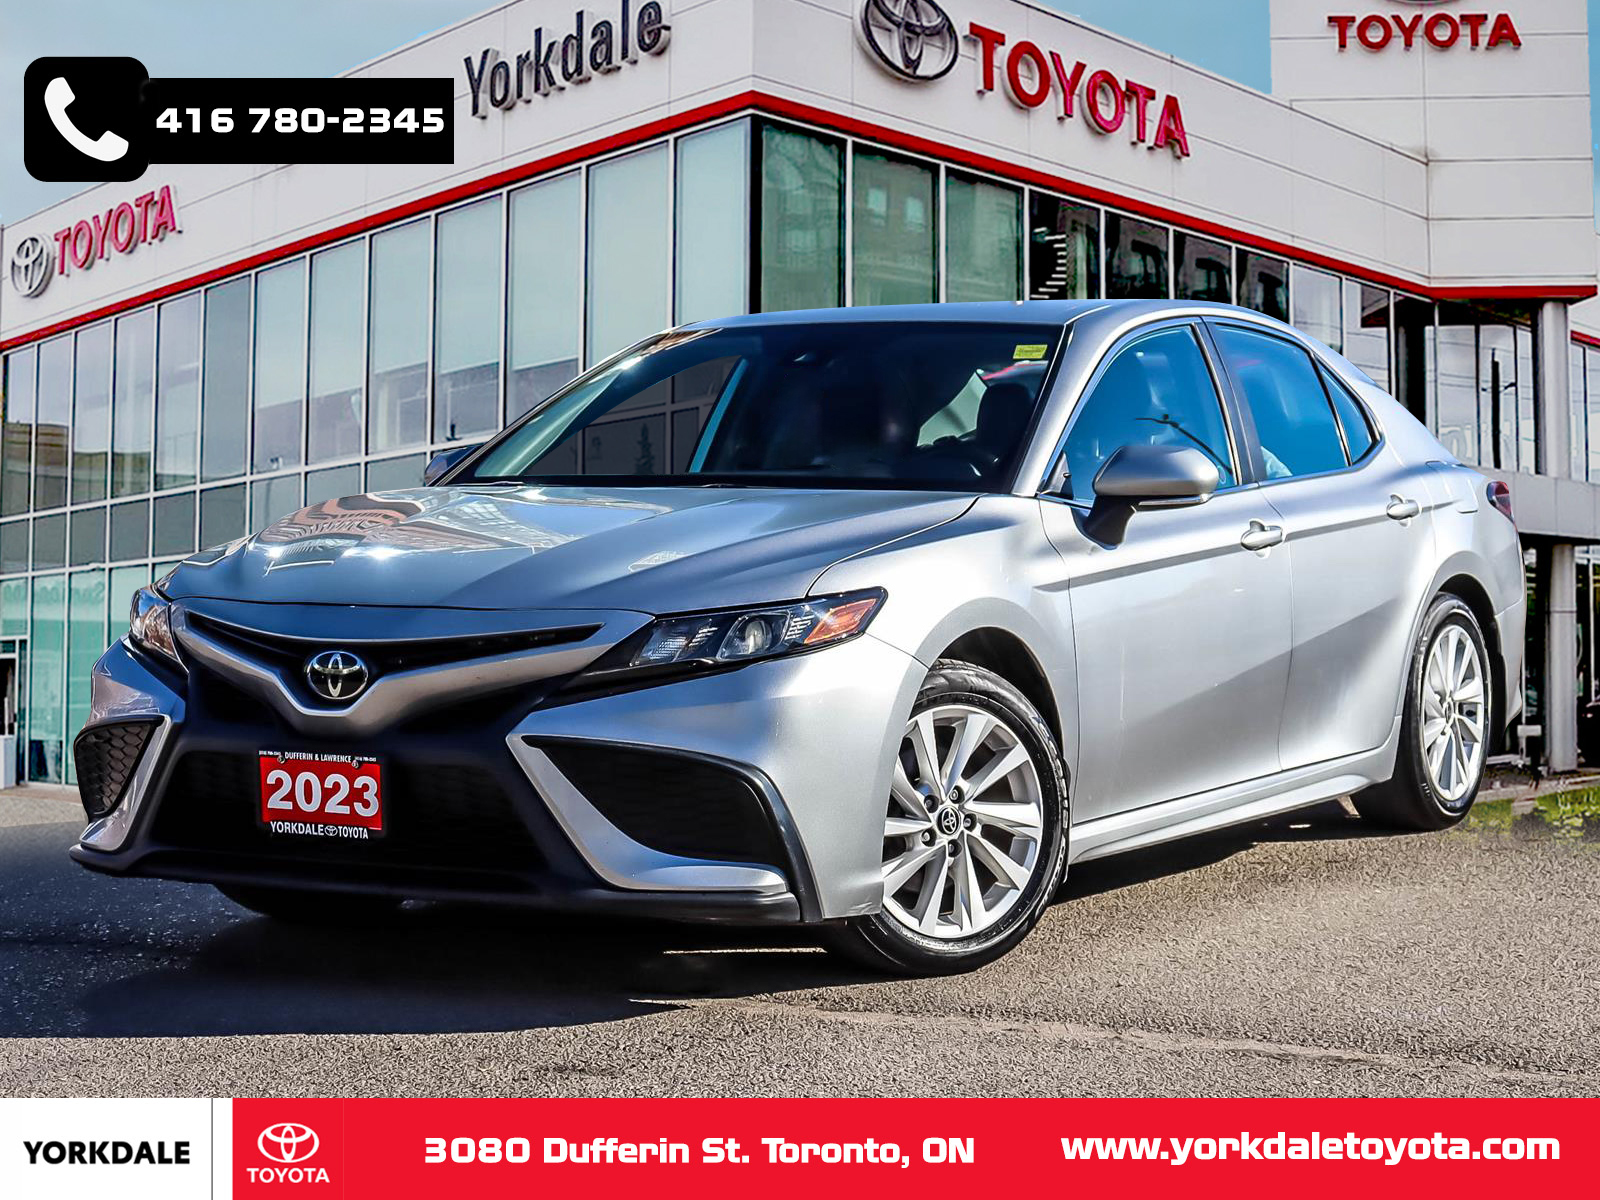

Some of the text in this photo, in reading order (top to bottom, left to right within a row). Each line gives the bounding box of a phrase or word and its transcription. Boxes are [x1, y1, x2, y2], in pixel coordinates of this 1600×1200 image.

[1327, 13, 1521, 51] TOYOTA
[463, 0, 672, 118] Yorkdale
[966, 22, 1191, 158] TOYOTA
[54, 185, 178, 276] TOYOTA
[284, 751, 313, 761] DUFFERIN
[321, 753, 352, 763] LAWRENCE
[266, 769, 380, 817] 2023
[270, 821, 369, 839] YORKDALE TOYOTA
